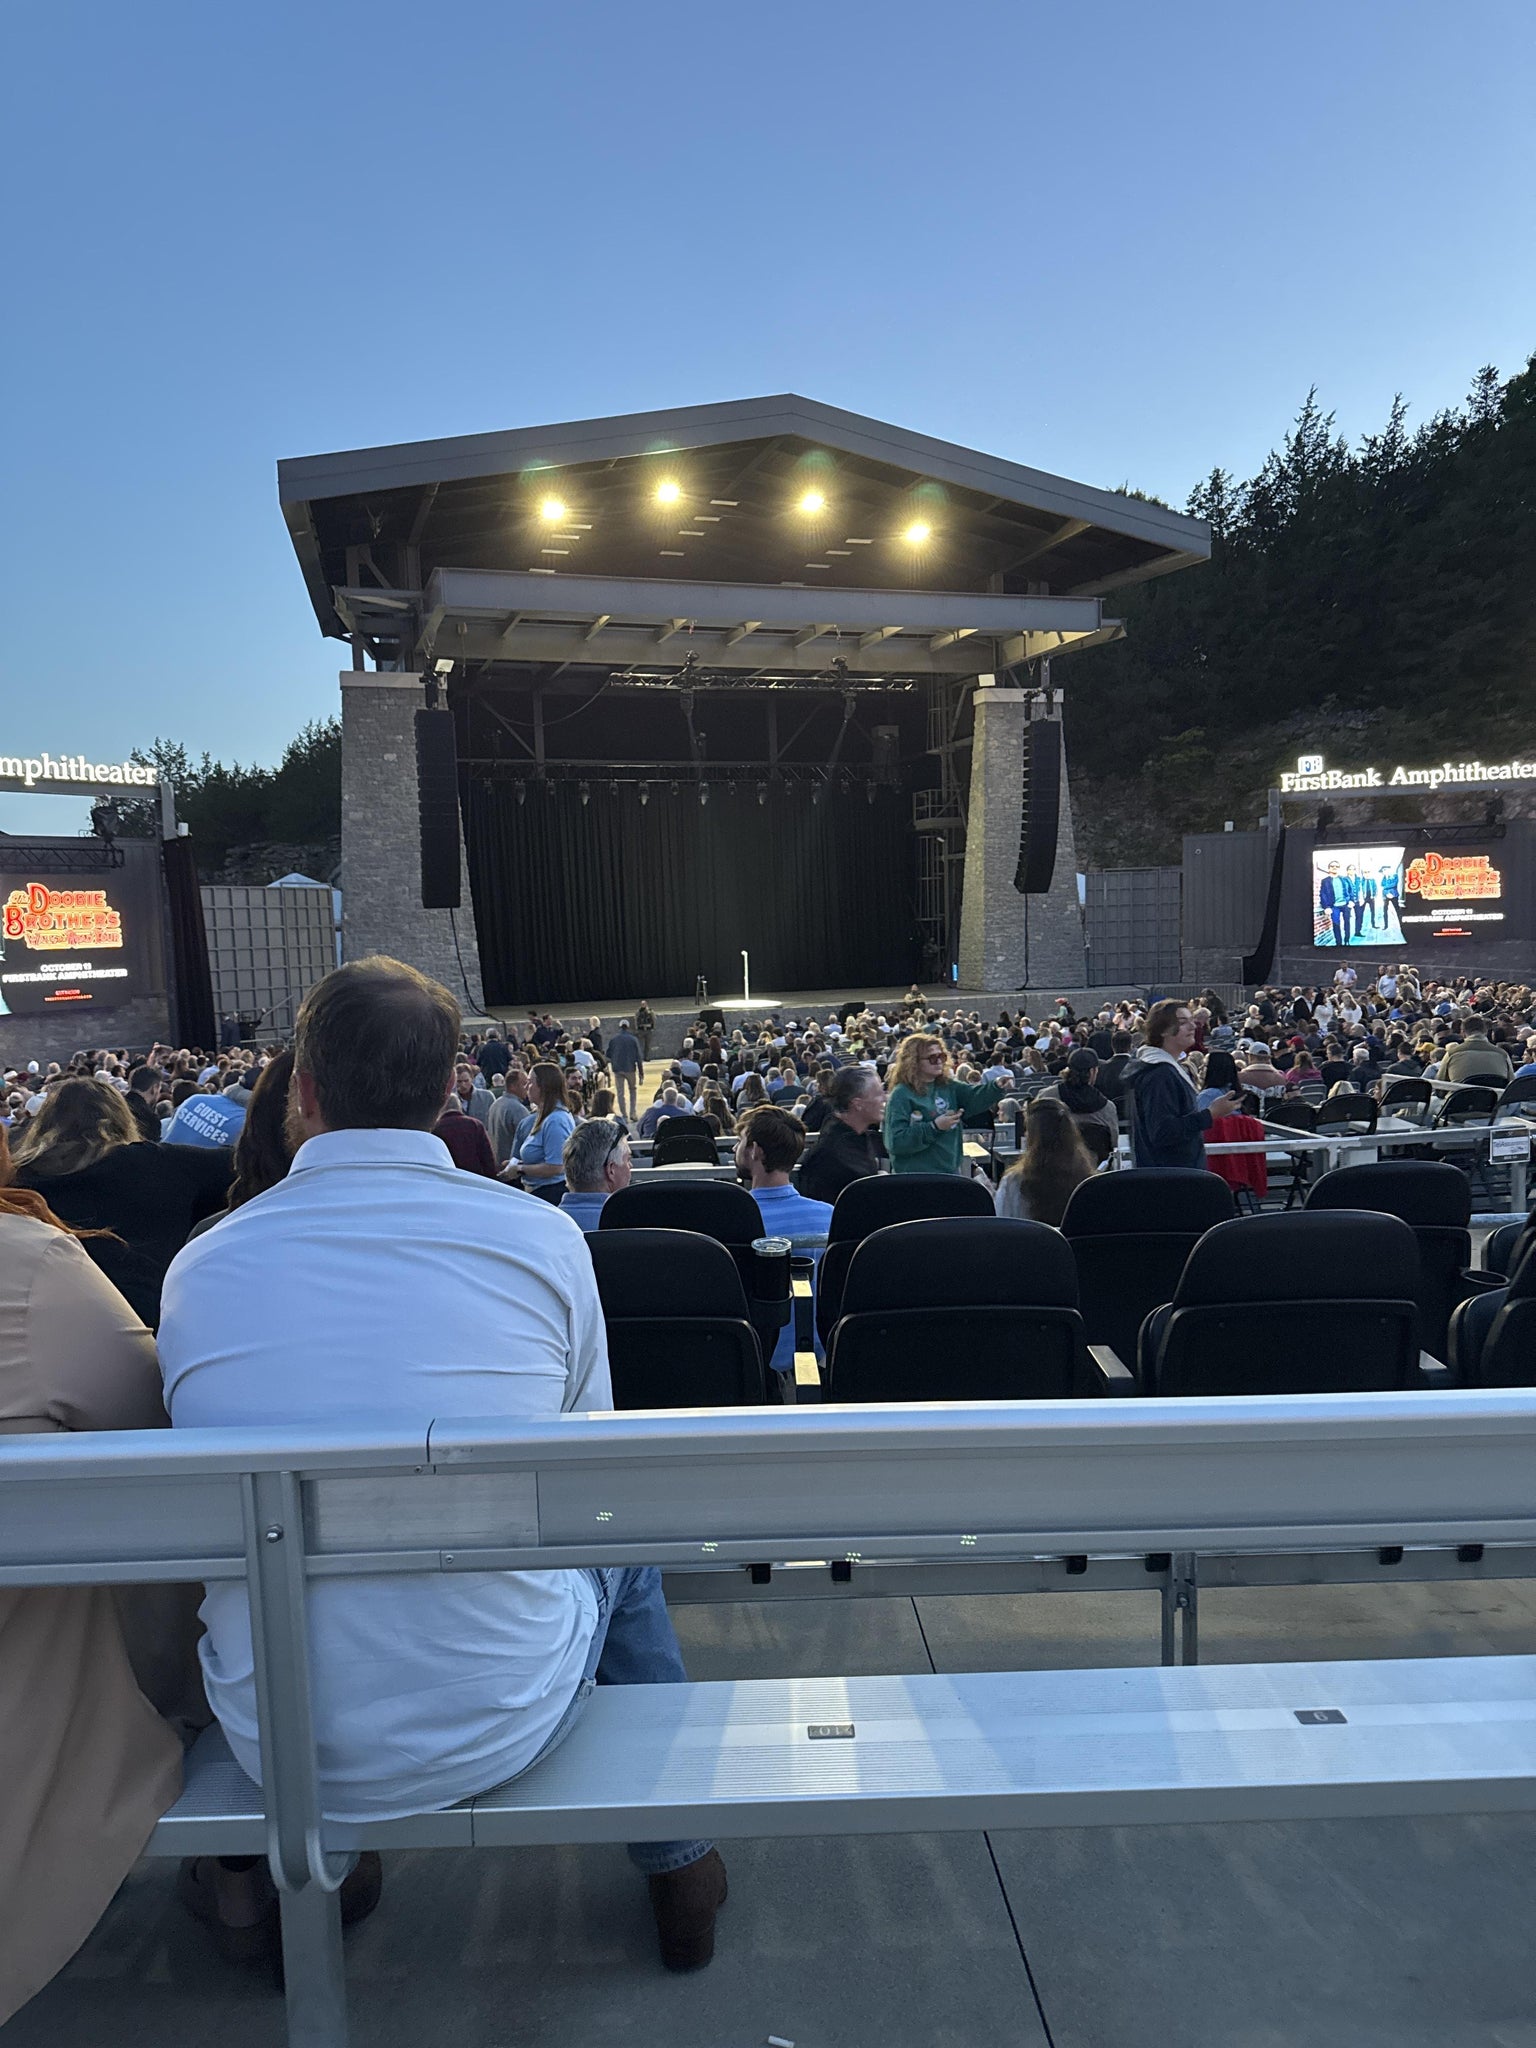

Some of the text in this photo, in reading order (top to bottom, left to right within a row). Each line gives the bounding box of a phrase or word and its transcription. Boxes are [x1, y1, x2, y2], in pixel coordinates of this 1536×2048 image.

[1280, 767, 1384, 793] FirstBank
[178, 1108, 229, 1144] SERVICES
[193, 1102, 229, 1128] GUEST
